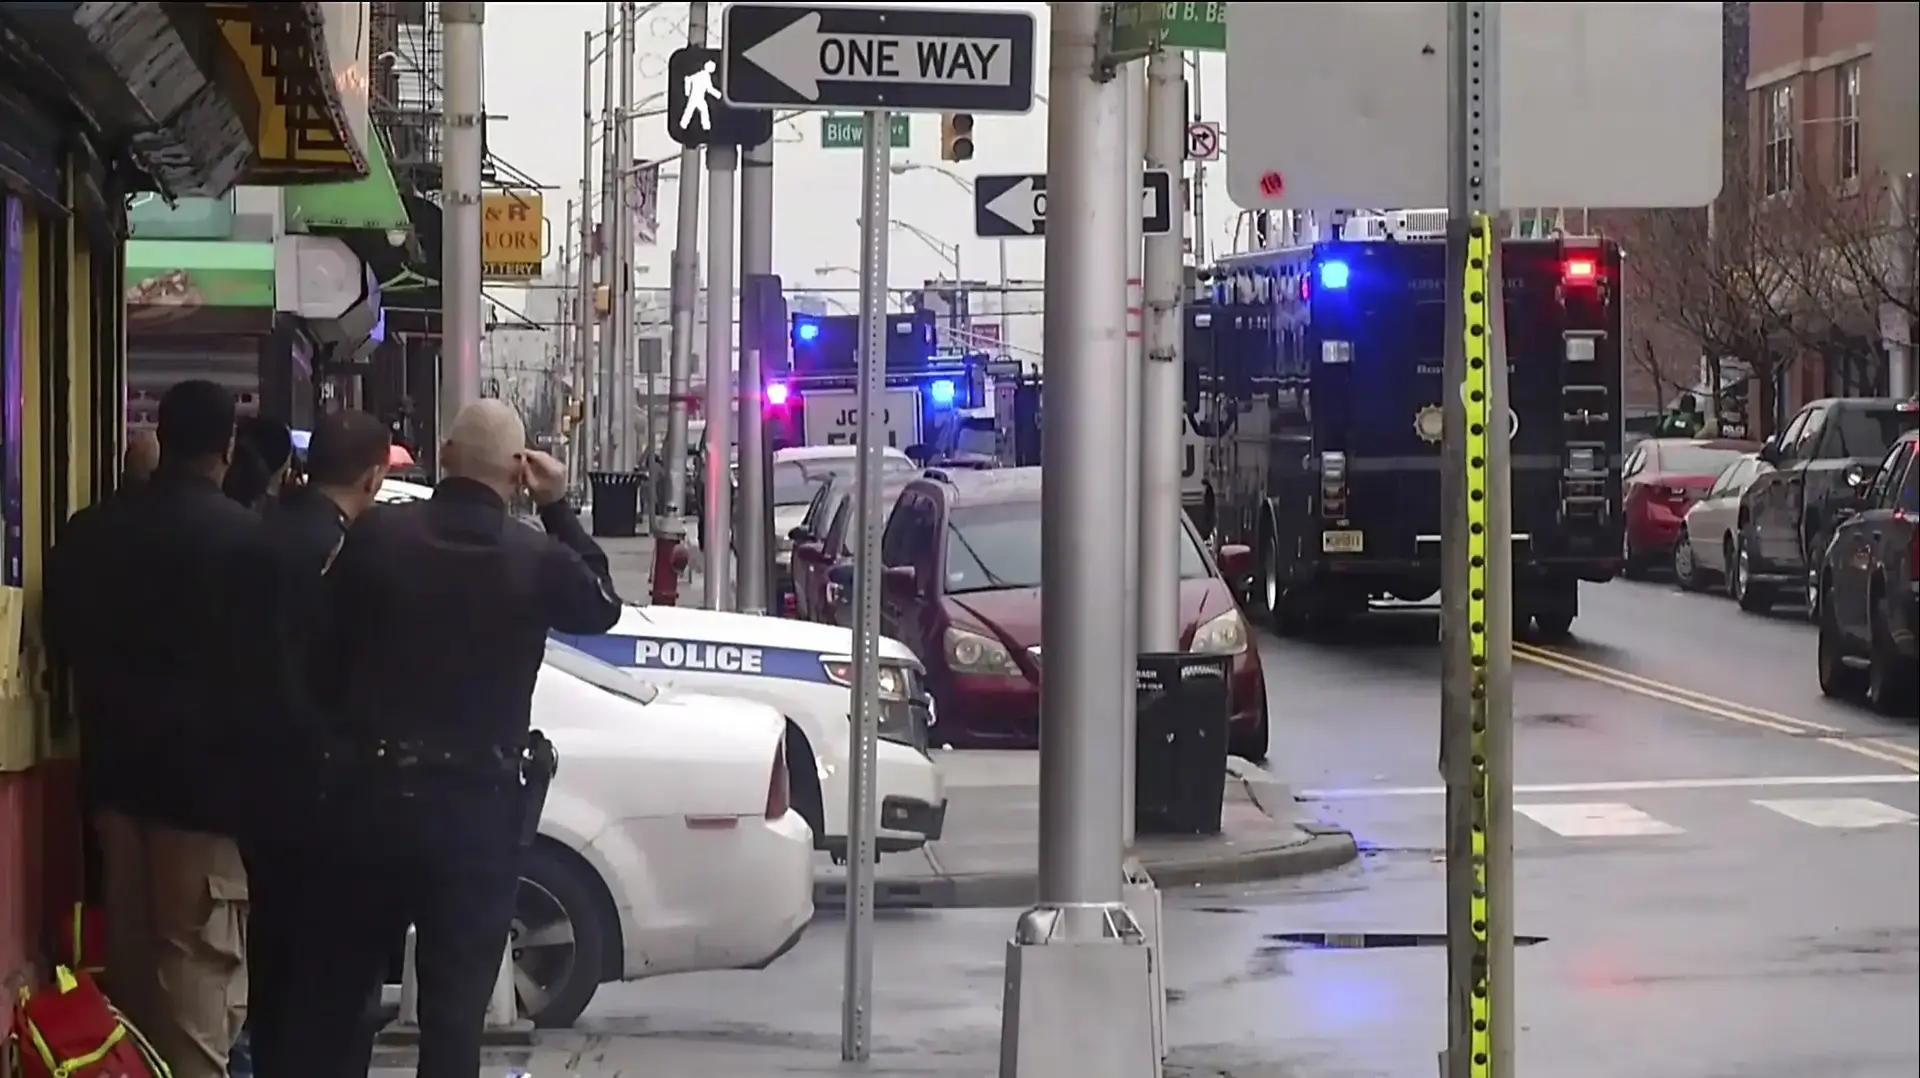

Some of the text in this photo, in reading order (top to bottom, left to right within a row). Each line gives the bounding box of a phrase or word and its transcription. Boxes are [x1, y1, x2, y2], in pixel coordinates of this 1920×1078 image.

[819, 38, 1000, 80] ONE WAY
[828, 123, 904, 142] Bidw ve
[485, 206, 502, 221] &
[485, 231, 539, 250] UORS
[483, 263, 535, 275] OTTERY
[635, 639, 763, 673] POLICE
[1136, 670, 1158, 679] RASH
